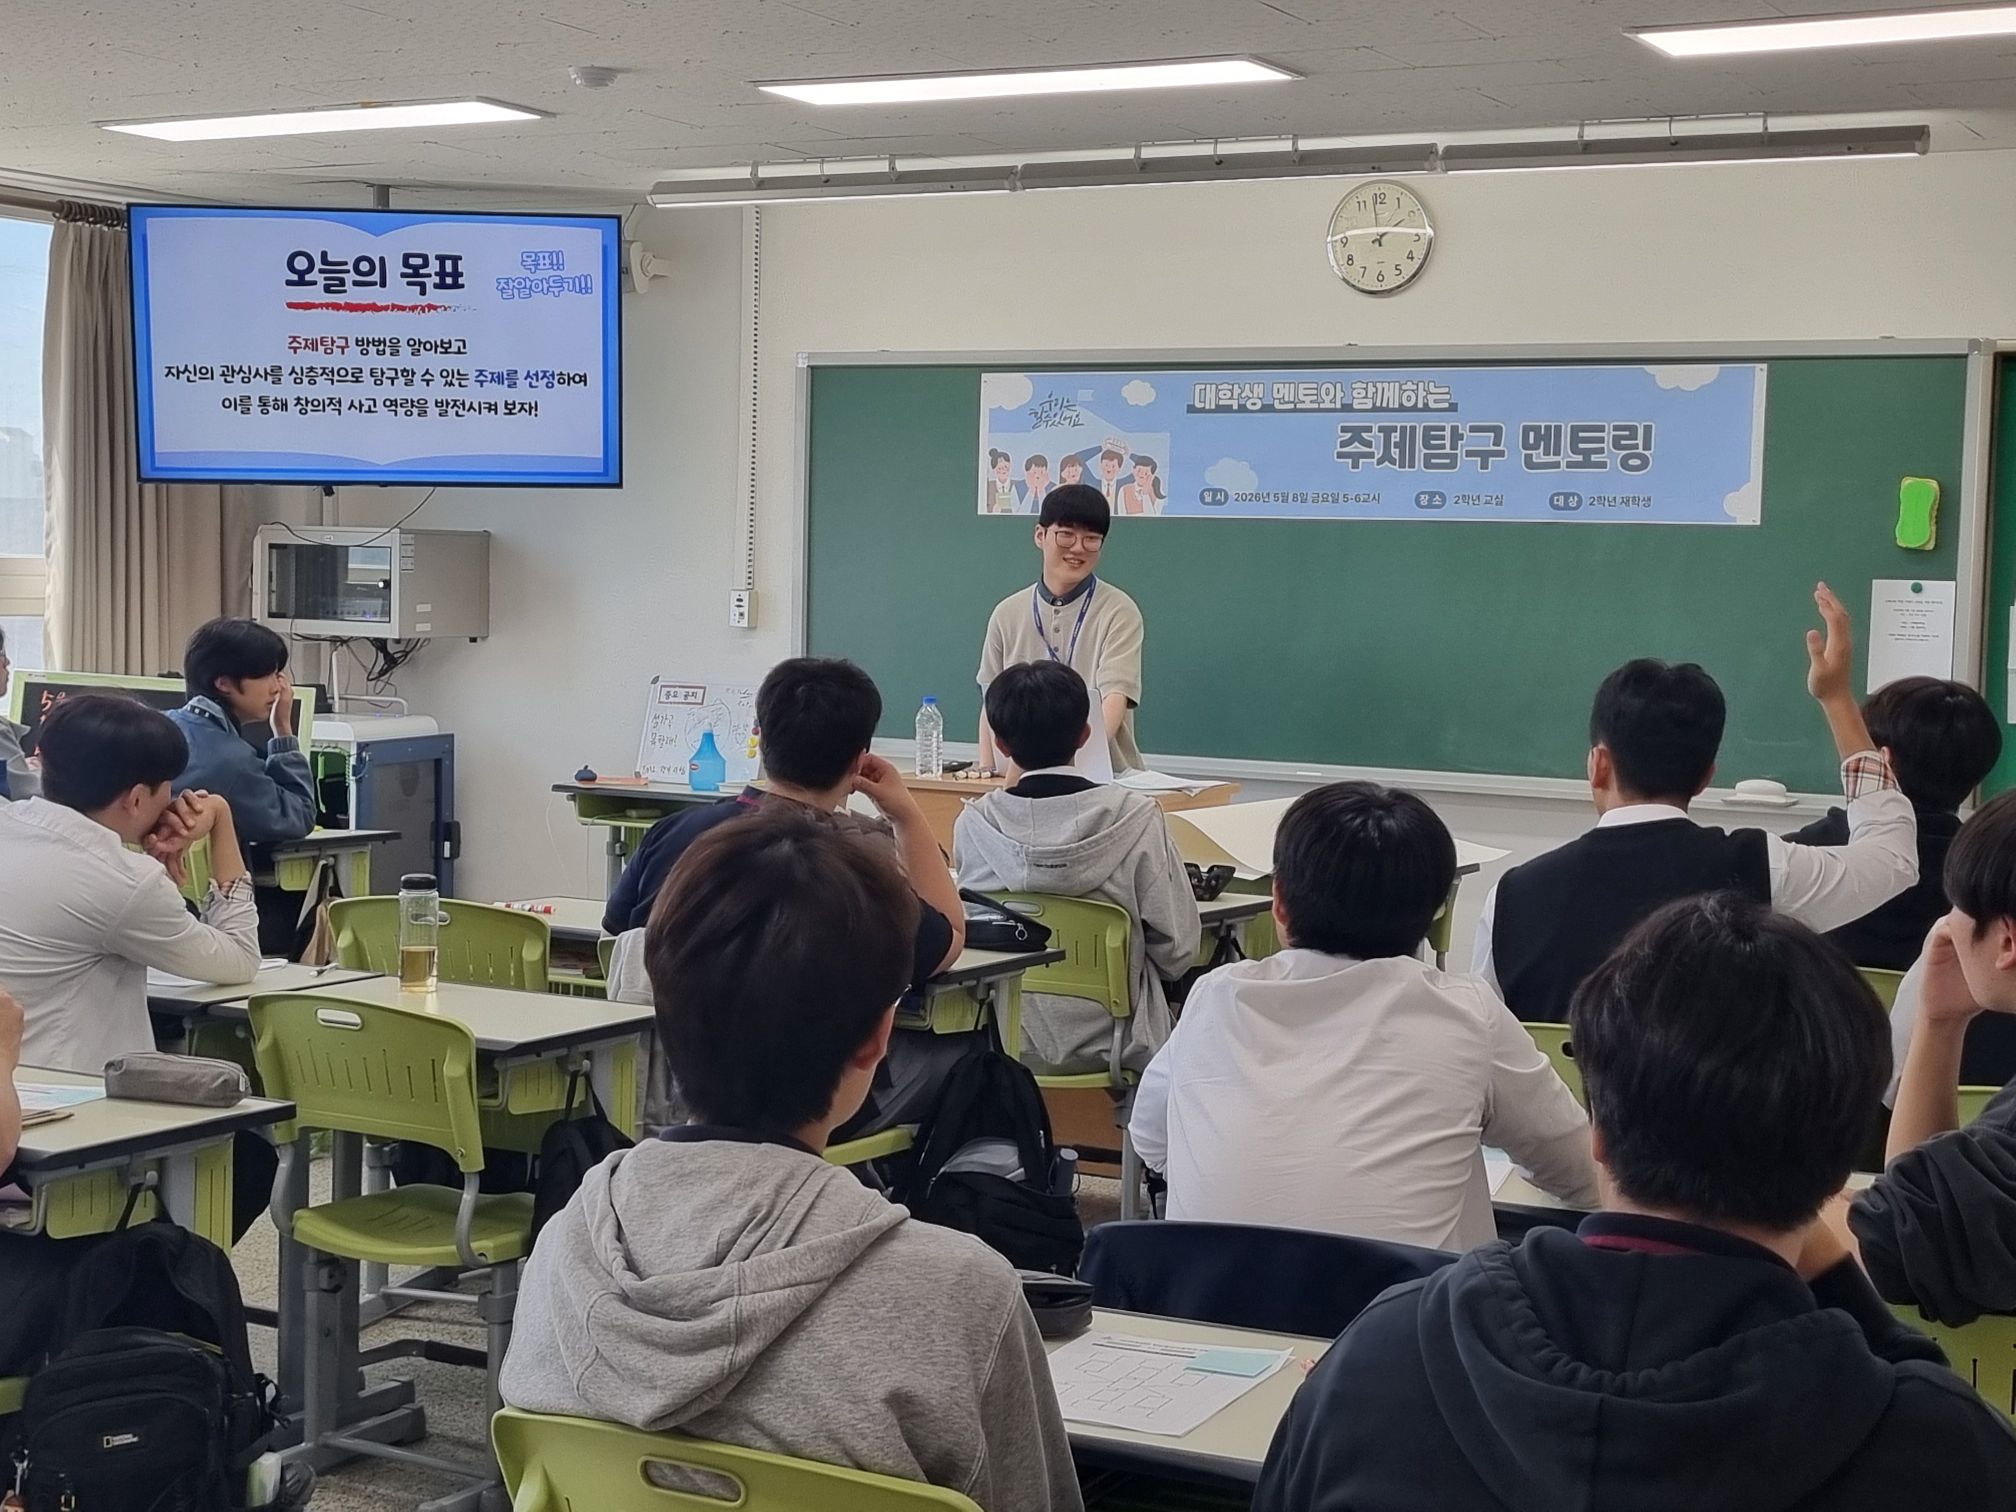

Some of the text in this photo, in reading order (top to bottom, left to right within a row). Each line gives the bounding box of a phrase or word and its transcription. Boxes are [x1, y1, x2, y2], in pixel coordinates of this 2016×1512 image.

[1373, 192, 1387, 205] 12
[1356, 200, 1367, 212] 11
[1340, 235, 1349, 248] 9
[520, 250, 565, 273] 목표!!
[1346, 254, 1355, 267] 8
[1406, 249, 1415, 262] 4
[285, 250, 466, 296] 오늘의 목표
[1359, 266, 1368, 279] 7
[1376, 270, 1385, 283] 6
[1394, 264, 1403, 277] 5
[496, 274, 593, 300] 잘알아두기!!
[287, 335, 468, 357] 주제탐구 방법을 알아보고
[164, 364, 588, 390] 자신의 관심사를 심층적으로 탐구할 수 있는 주제를 선정하여
[1192, 380, 1453, 411] 대학생 멘토와 함께하는
[221, 395, 539, 418] 이를 통해 창의적 사고 역량을 발전시켜 보자!
[1335, 422, 1656, 474] 주제탐구 멘토링
[1234, 491, 1271, 504] 2026년
[1273, 491, 1290, 504] 5월
[1292, 491, 1308, 504] 8일
[1311, 491, 1340, 504] 금요일
[1342, 492, 1381, 505] 5-6교시
[1453, 493, 1482, 506] 2학년
[1484, 494, 1504, 507] 교실
[1588, 495, 1618, 508] 2학년
[1620, 495, 1652, 509] 재학생
